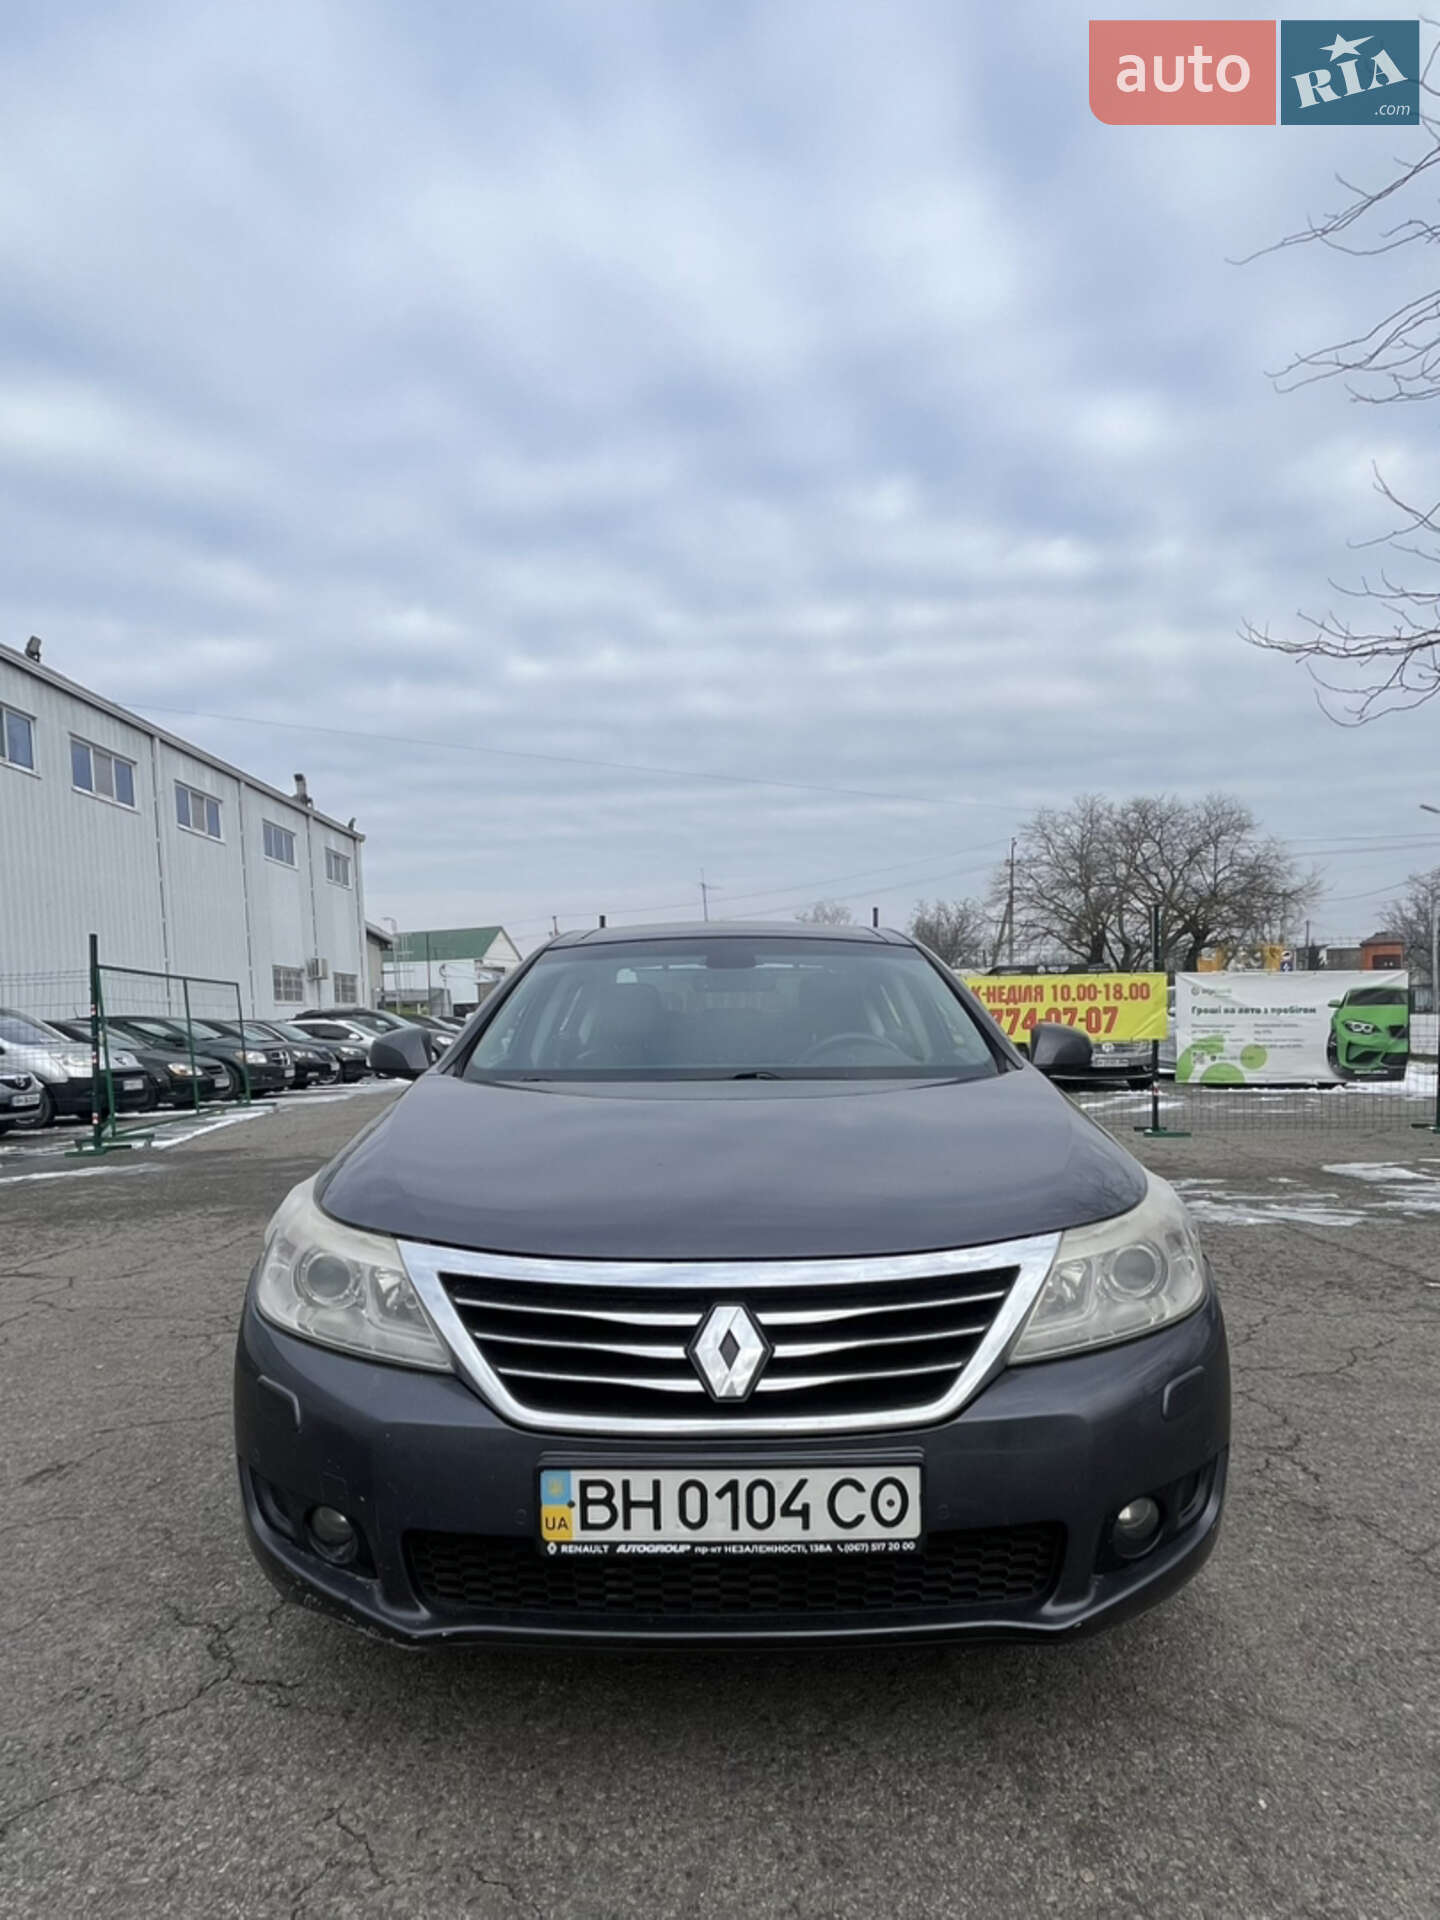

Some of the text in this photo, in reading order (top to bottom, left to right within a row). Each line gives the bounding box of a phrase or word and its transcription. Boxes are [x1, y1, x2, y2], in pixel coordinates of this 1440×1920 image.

[1051, 982, 1151, 1002] 10.00-18.00
[579, 1476, 910, 1531] BH 0104 CO
[545, 1516, 569, 1531] UA
[560, 1544, 609, 1554] RENAULT
[616, 1543, 691, 1554] AUTOGROUP
